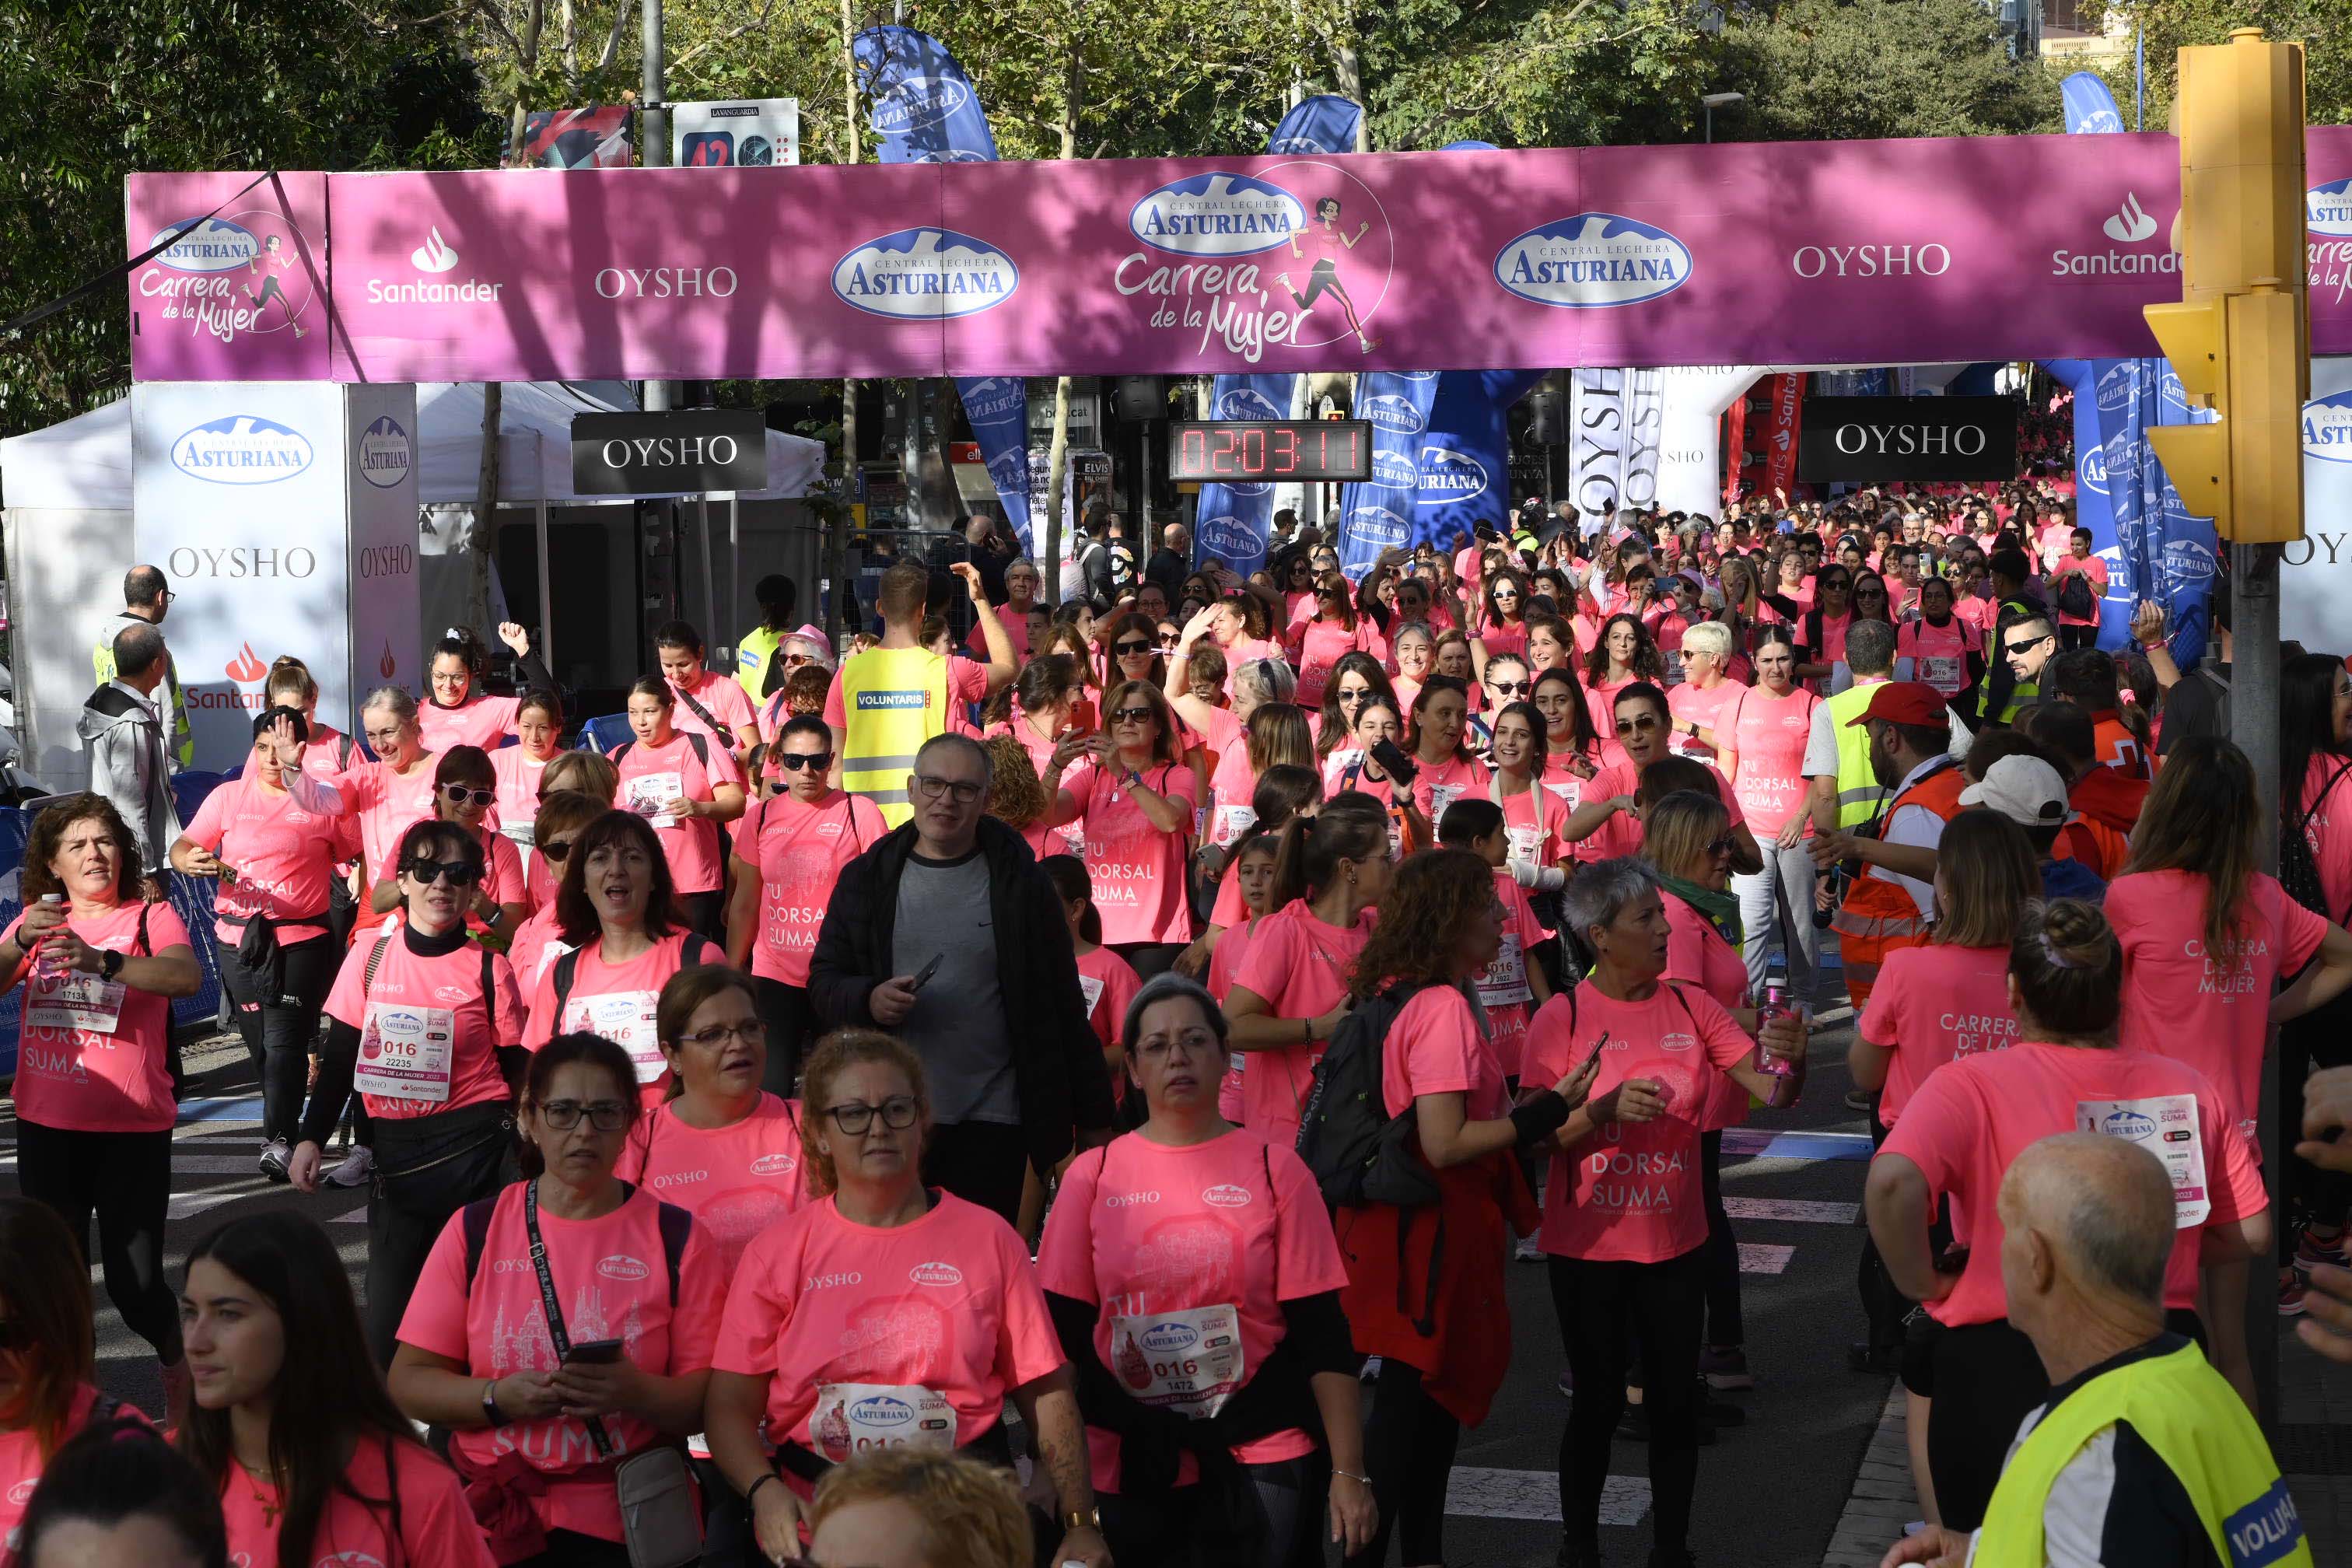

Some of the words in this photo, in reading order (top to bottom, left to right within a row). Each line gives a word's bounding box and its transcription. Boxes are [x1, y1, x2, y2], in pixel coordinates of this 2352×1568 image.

[1171, 201, 1226, 210] CENTRAL
[1231, 201, 1287, 209] LECHERA
[1143, 205, 1291, 236] ASTURIANA
[1540, 247, 1601, 257] CENTRAL
[1607, 245, 1670, 254] LECHERA
[875, 260, 933, 268] CENTRAL
[940, 258, 998, 268] LECHERA
[1510, 249, 1676, 284] ASTURIANA
[1793, 243, 1951, 279] OYSHO
[140, 268, 230, 297] Carrera
[595, 266, 738, 299] OYSHO
[846, 262, 1003, 296] ASTURIANA
[1115, 253, 1259, 296] Carrera
[367, 279, 502, 305] Santander
[162, 299, 180, 318] de
[182, 299, 194, 319] la
[193, 296, 265, 343] Mujer
[1150, 298, 1178, 328] de
[1183, 297, 1202, 328] la
[1199, 291, 1314, 363] Mujer
[1835, 423, 1986, 456] OYSHO
[182, 440, 303, 467] ASTURIANA
[362, 440, 408, 472] ASTURIANA
[603, 436, 737, 468] OYSHO
[1182, 429, 1356, 473] 02:03:11
[1084, 463, 1108, 473] ELVIS
[169, 547, 316, 578] OYSHO
[360, 544, 411, 579] OYSHO
[859, 694, 923, 705] VOLUNTARIS
[1745, 777, 1797, 791] DORSAL
[644, 796, 663, 804] 016
[1090, 863, 1154, 879] DORSAL
[1091, 885, 1136, 901] SUMA
[770, 927, 817, 947] SUMA
[1491, 961, 1513, 973] 016
[2198, 976, 2255, 993] MUJER
[62, 991, 86, 1000] 17138
[384, 1020, 421, 1031] ASTURIANA
[384, 1041, 417, 1056] 016
[1958, 1033, 1979, 1050] DE
[25, 1048, 87, 1076] SUMA
[386, 1058, 411, 1068] 22235
[361, 1079, 387, 1088] OYSHO
[410, 1085, 442, 1094] Santander
[2105, 1124, 2152, 1136] ASTURIANA
[654, 1170, 709, 1188] OYSHO
[1106, 1190, 1160, 1208] OYSHO
[1592, 1183, 1671, 1207] SUMA
[1108, 1291, 1145, 1318] TU
[1202, 1322, 1228, 1332] SUMA
[1145, 1334, 1195, 1347] ASTURIANA
[1153, 1360, 1198, 1377] 016
[1167, 1381, 1194, 1391] 1472
[854, 1407, 909, 1419] ASTURIANA
